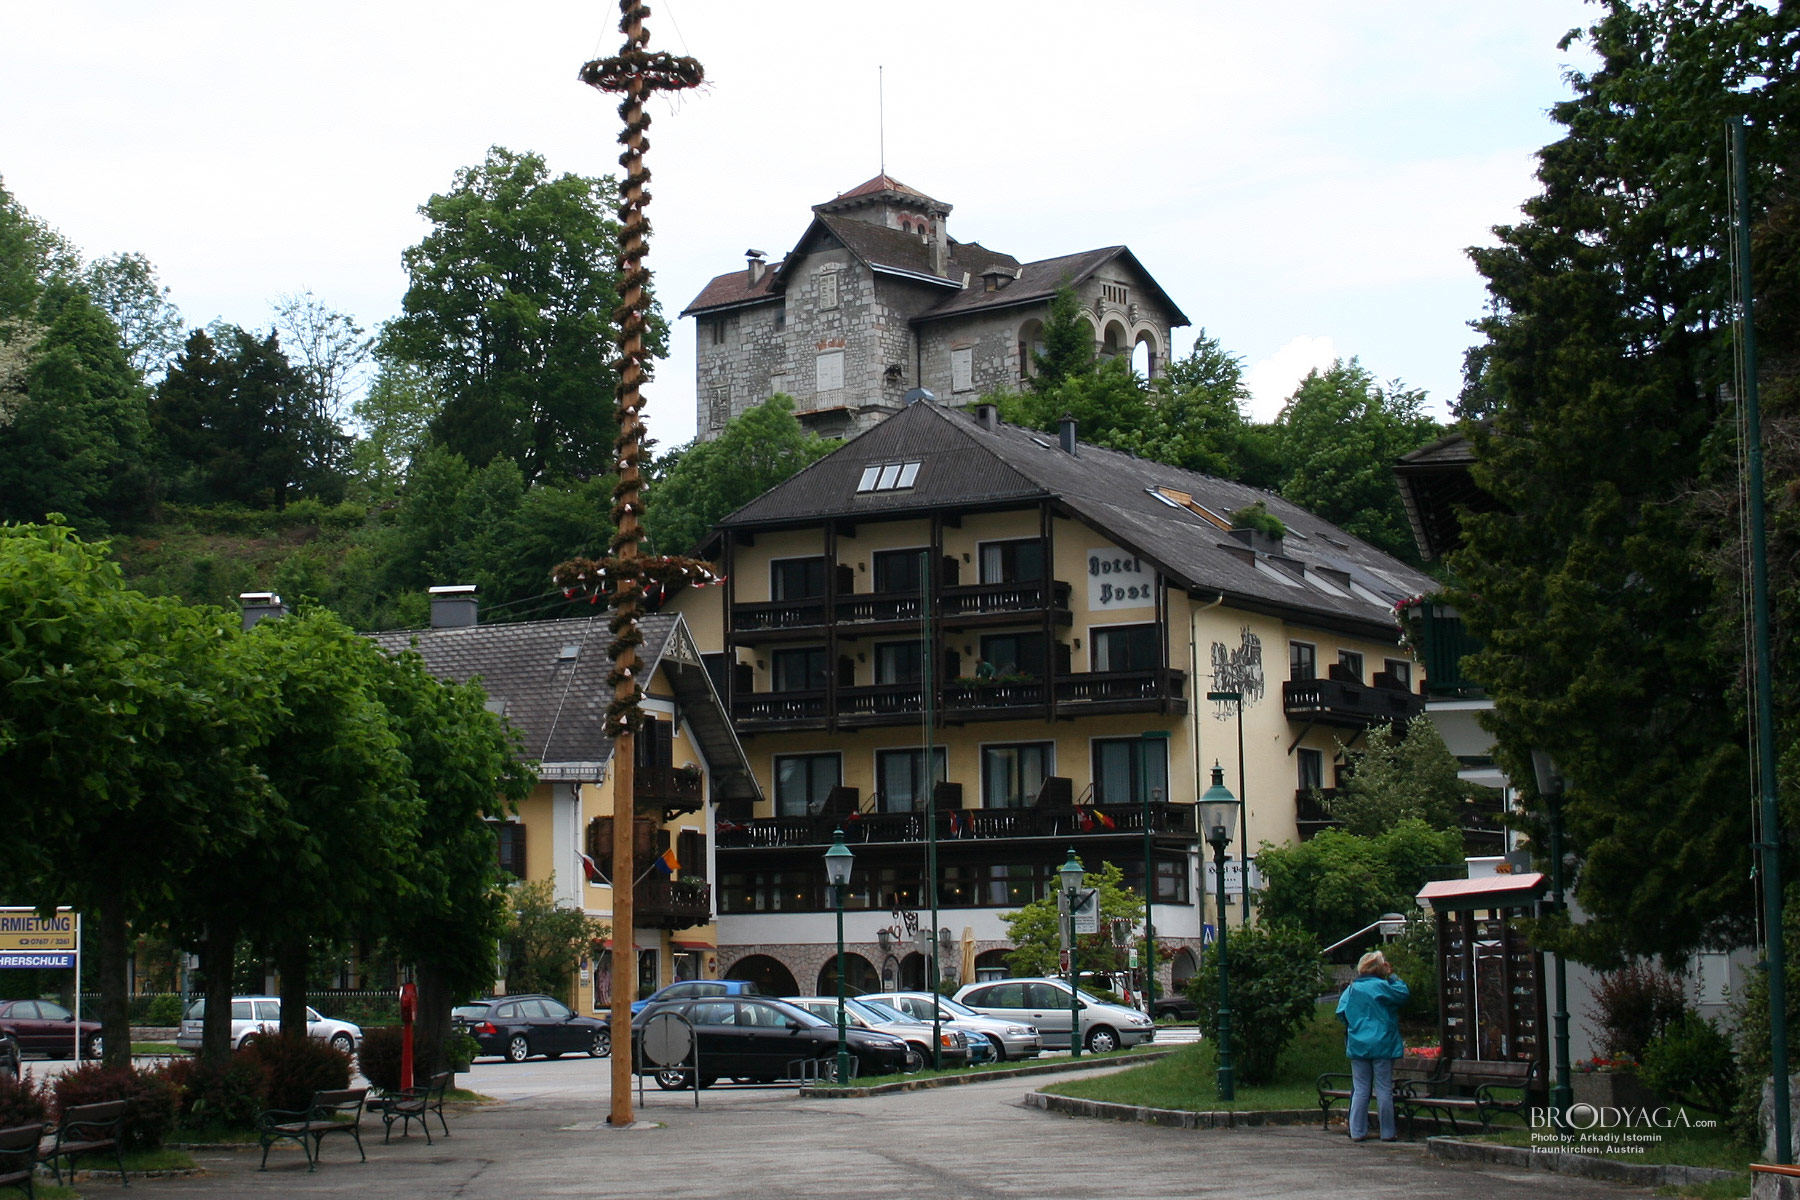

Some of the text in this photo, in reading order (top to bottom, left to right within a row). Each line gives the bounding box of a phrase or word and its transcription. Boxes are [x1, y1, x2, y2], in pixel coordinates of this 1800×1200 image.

[1088, 556, 1141, 577] Hotel
[1099, 583, 1150, 605] Post
[0, 917, 70, 931] RMIETUNG
